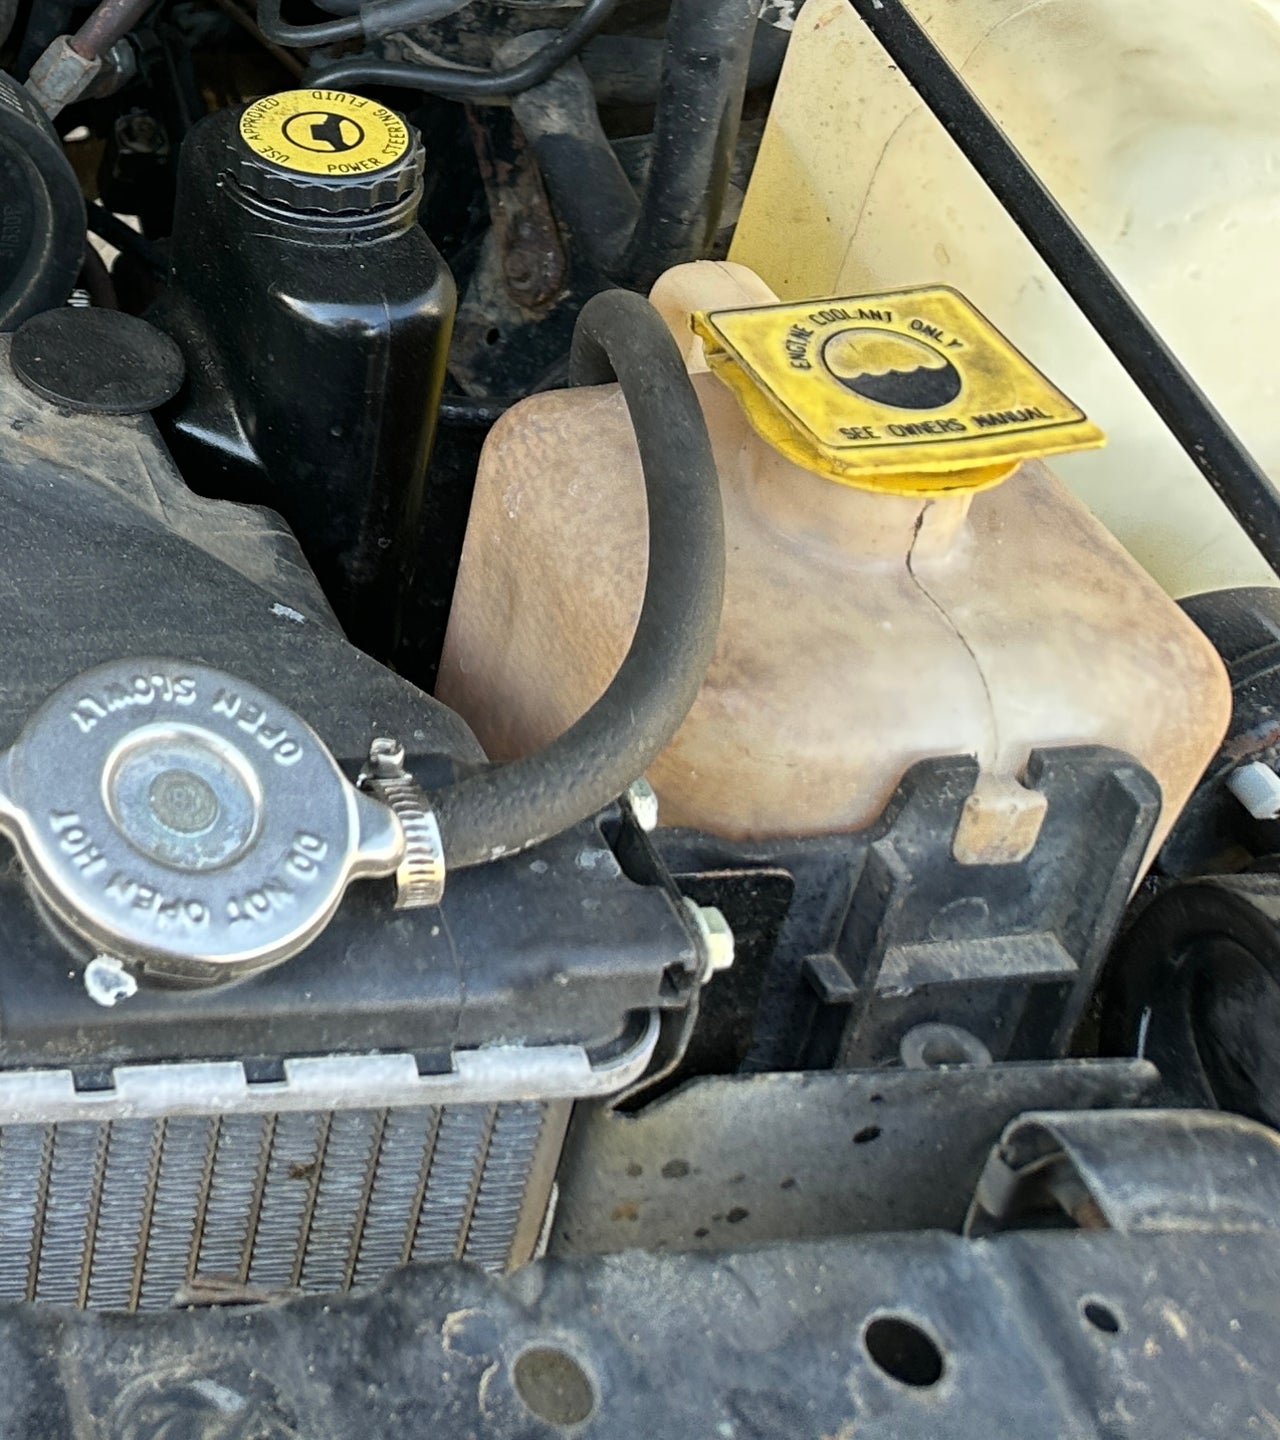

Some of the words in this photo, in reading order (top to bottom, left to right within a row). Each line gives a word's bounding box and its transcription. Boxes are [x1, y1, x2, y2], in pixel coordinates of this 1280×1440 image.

[241, 97, 280, 140] APPROVED
[311, 91, 368, 109] FLUID
[256, 146, 290, 164] USE
[372, 108, 406, 157] STEERING
[327, 158, 384, 174] POWER
[785, 323, 815, 371] ENGINE
[808, 308, 893, 326] COOLANT
[910, 318, 964, 349] ONLY
[838, 426, 881, 440] SEE
[887, 417, 967, 438] OWNERS
[971, 407, 1054, 428] MANUAL
[69, 673, 197, 734] SLOWLY
[211, 686, 305, 768] OPEN
[49, 807, 105, 880] HOT
[284, 830, 330, 882] DO
[104, 875, 212, 931] OPEN
[226, 877, 296, 928] NOT
